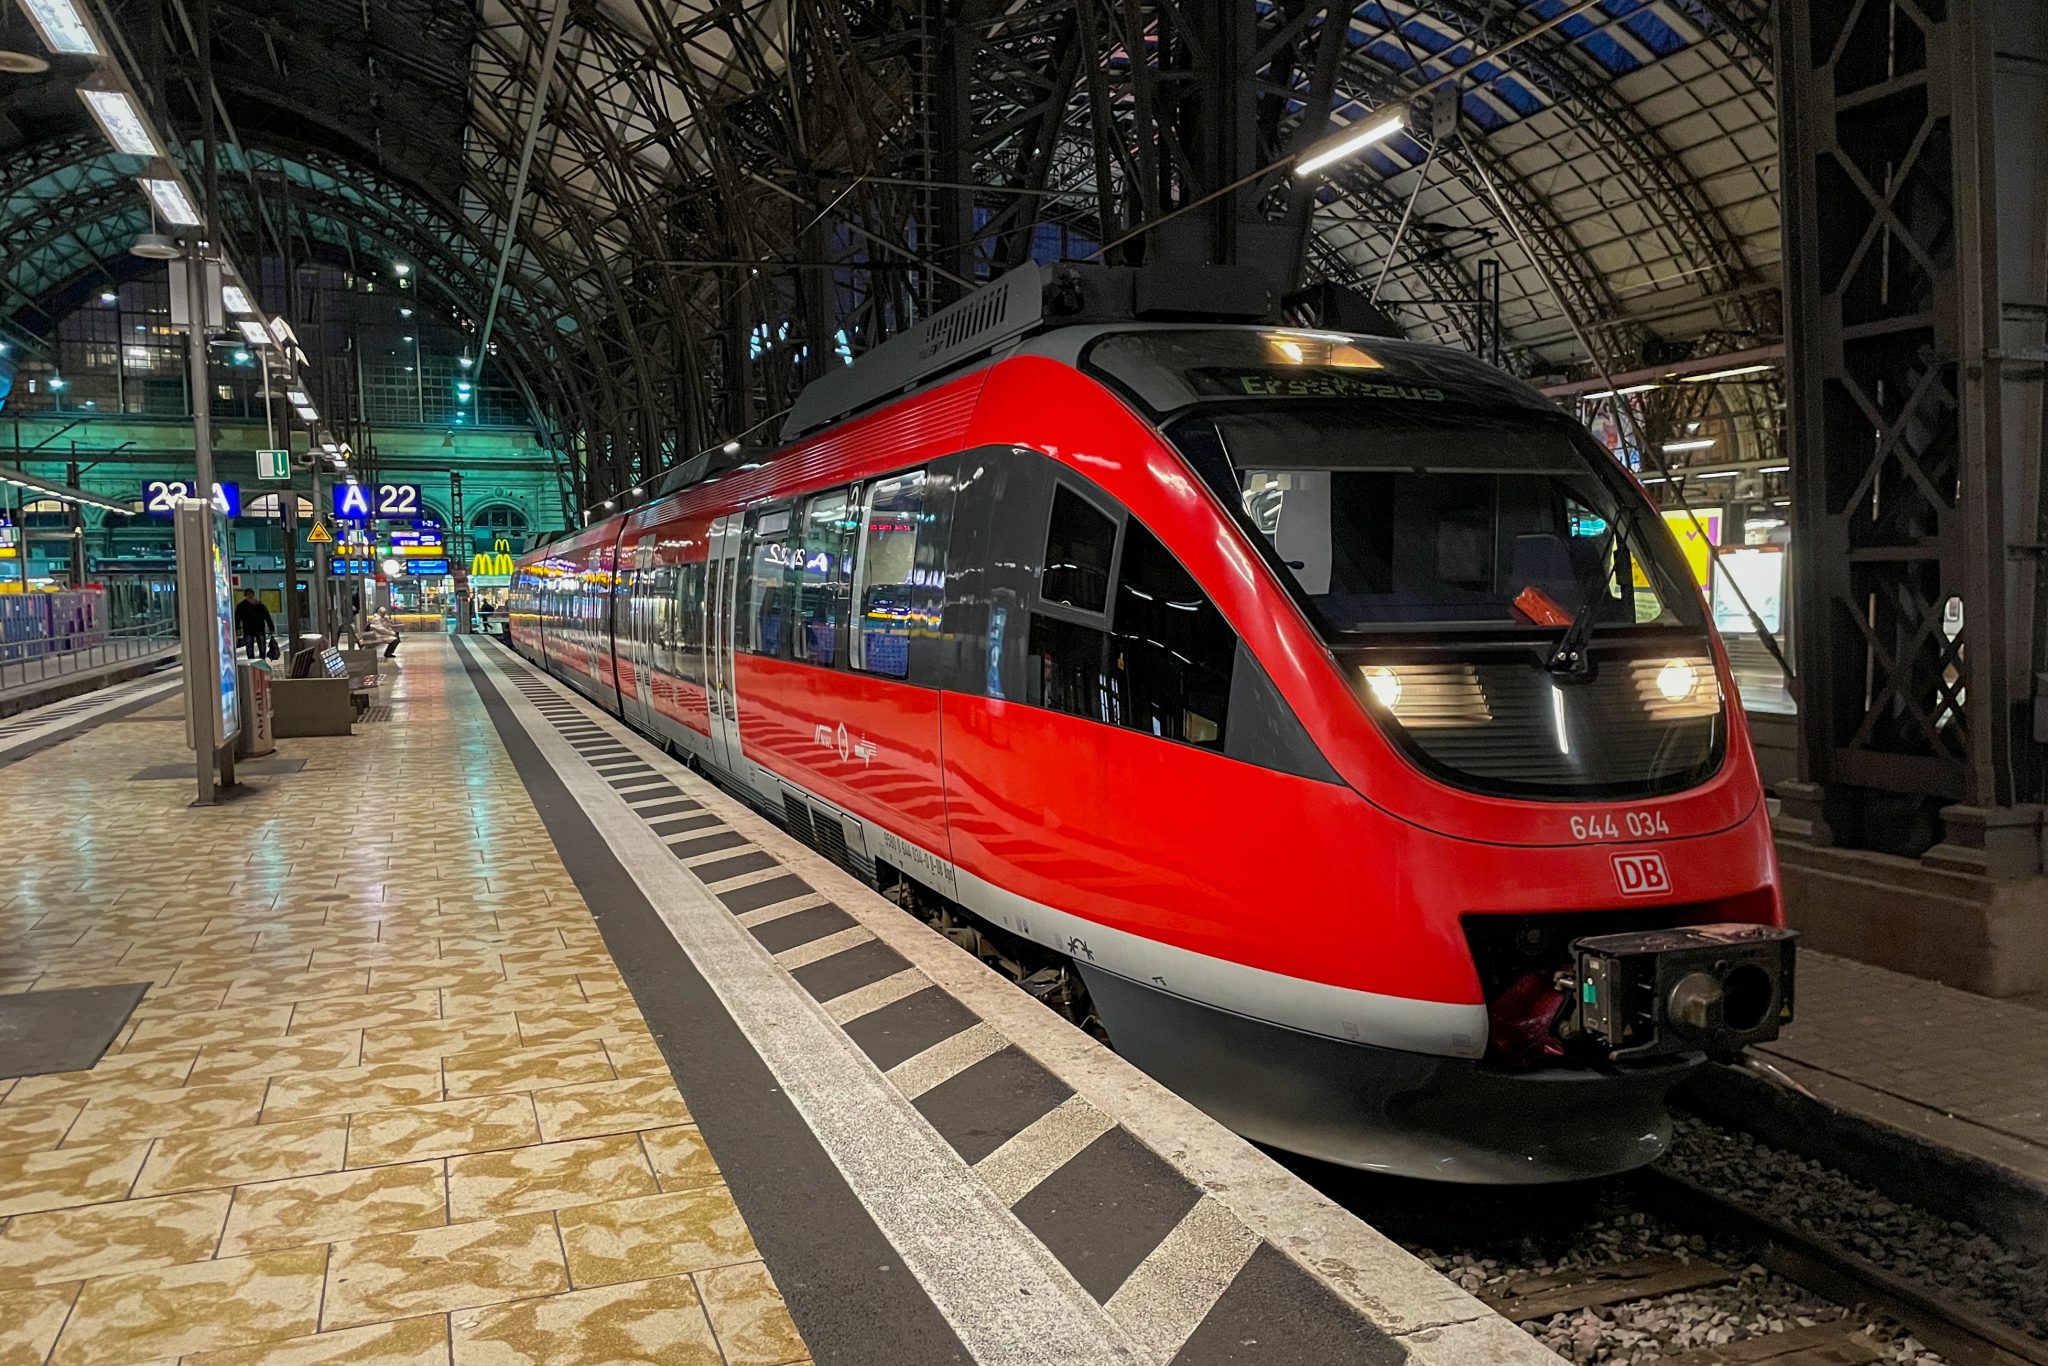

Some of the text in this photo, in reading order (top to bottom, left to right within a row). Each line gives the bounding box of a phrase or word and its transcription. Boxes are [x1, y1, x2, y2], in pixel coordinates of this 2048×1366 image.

[148, 482, 188, 511] 23
[210, 482, 230, 512] A
[342, 485, 368, 512] A
[379, 485, 417, 512] 22
[255, 692, 264, 740] Abfall
[1570, 810, 1669, 840] 644 034
[1618, 858, 1664, 890] DB
